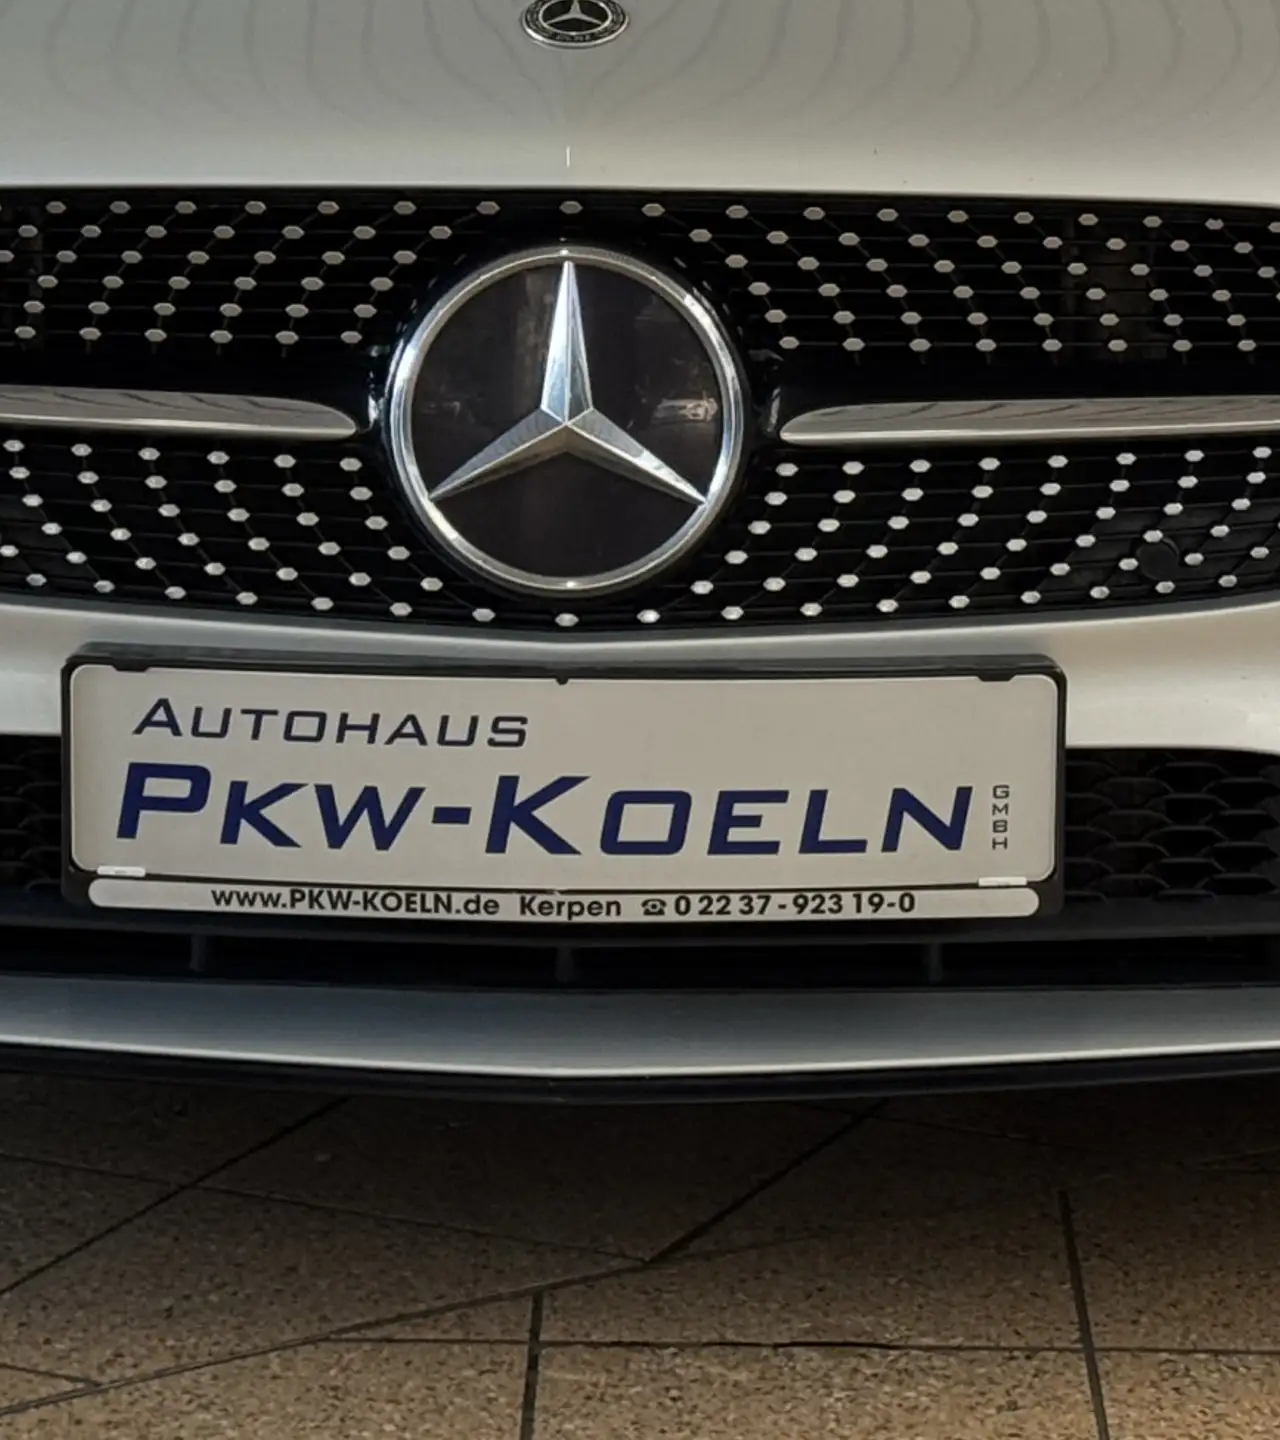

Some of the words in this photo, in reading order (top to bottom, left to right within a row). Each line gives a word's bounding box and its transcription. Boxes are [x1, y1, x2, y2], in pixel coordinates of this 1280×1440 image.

[131, 697, 529, 748] AUTOHAUS
[115, 761, 974, 856] PKW-KOELN
[991, 784, 1010, 851] GMBH
[210, 888, 501, 917] www.PKW-KOELN.de
[518, 895, 622, 921] Kerpen
